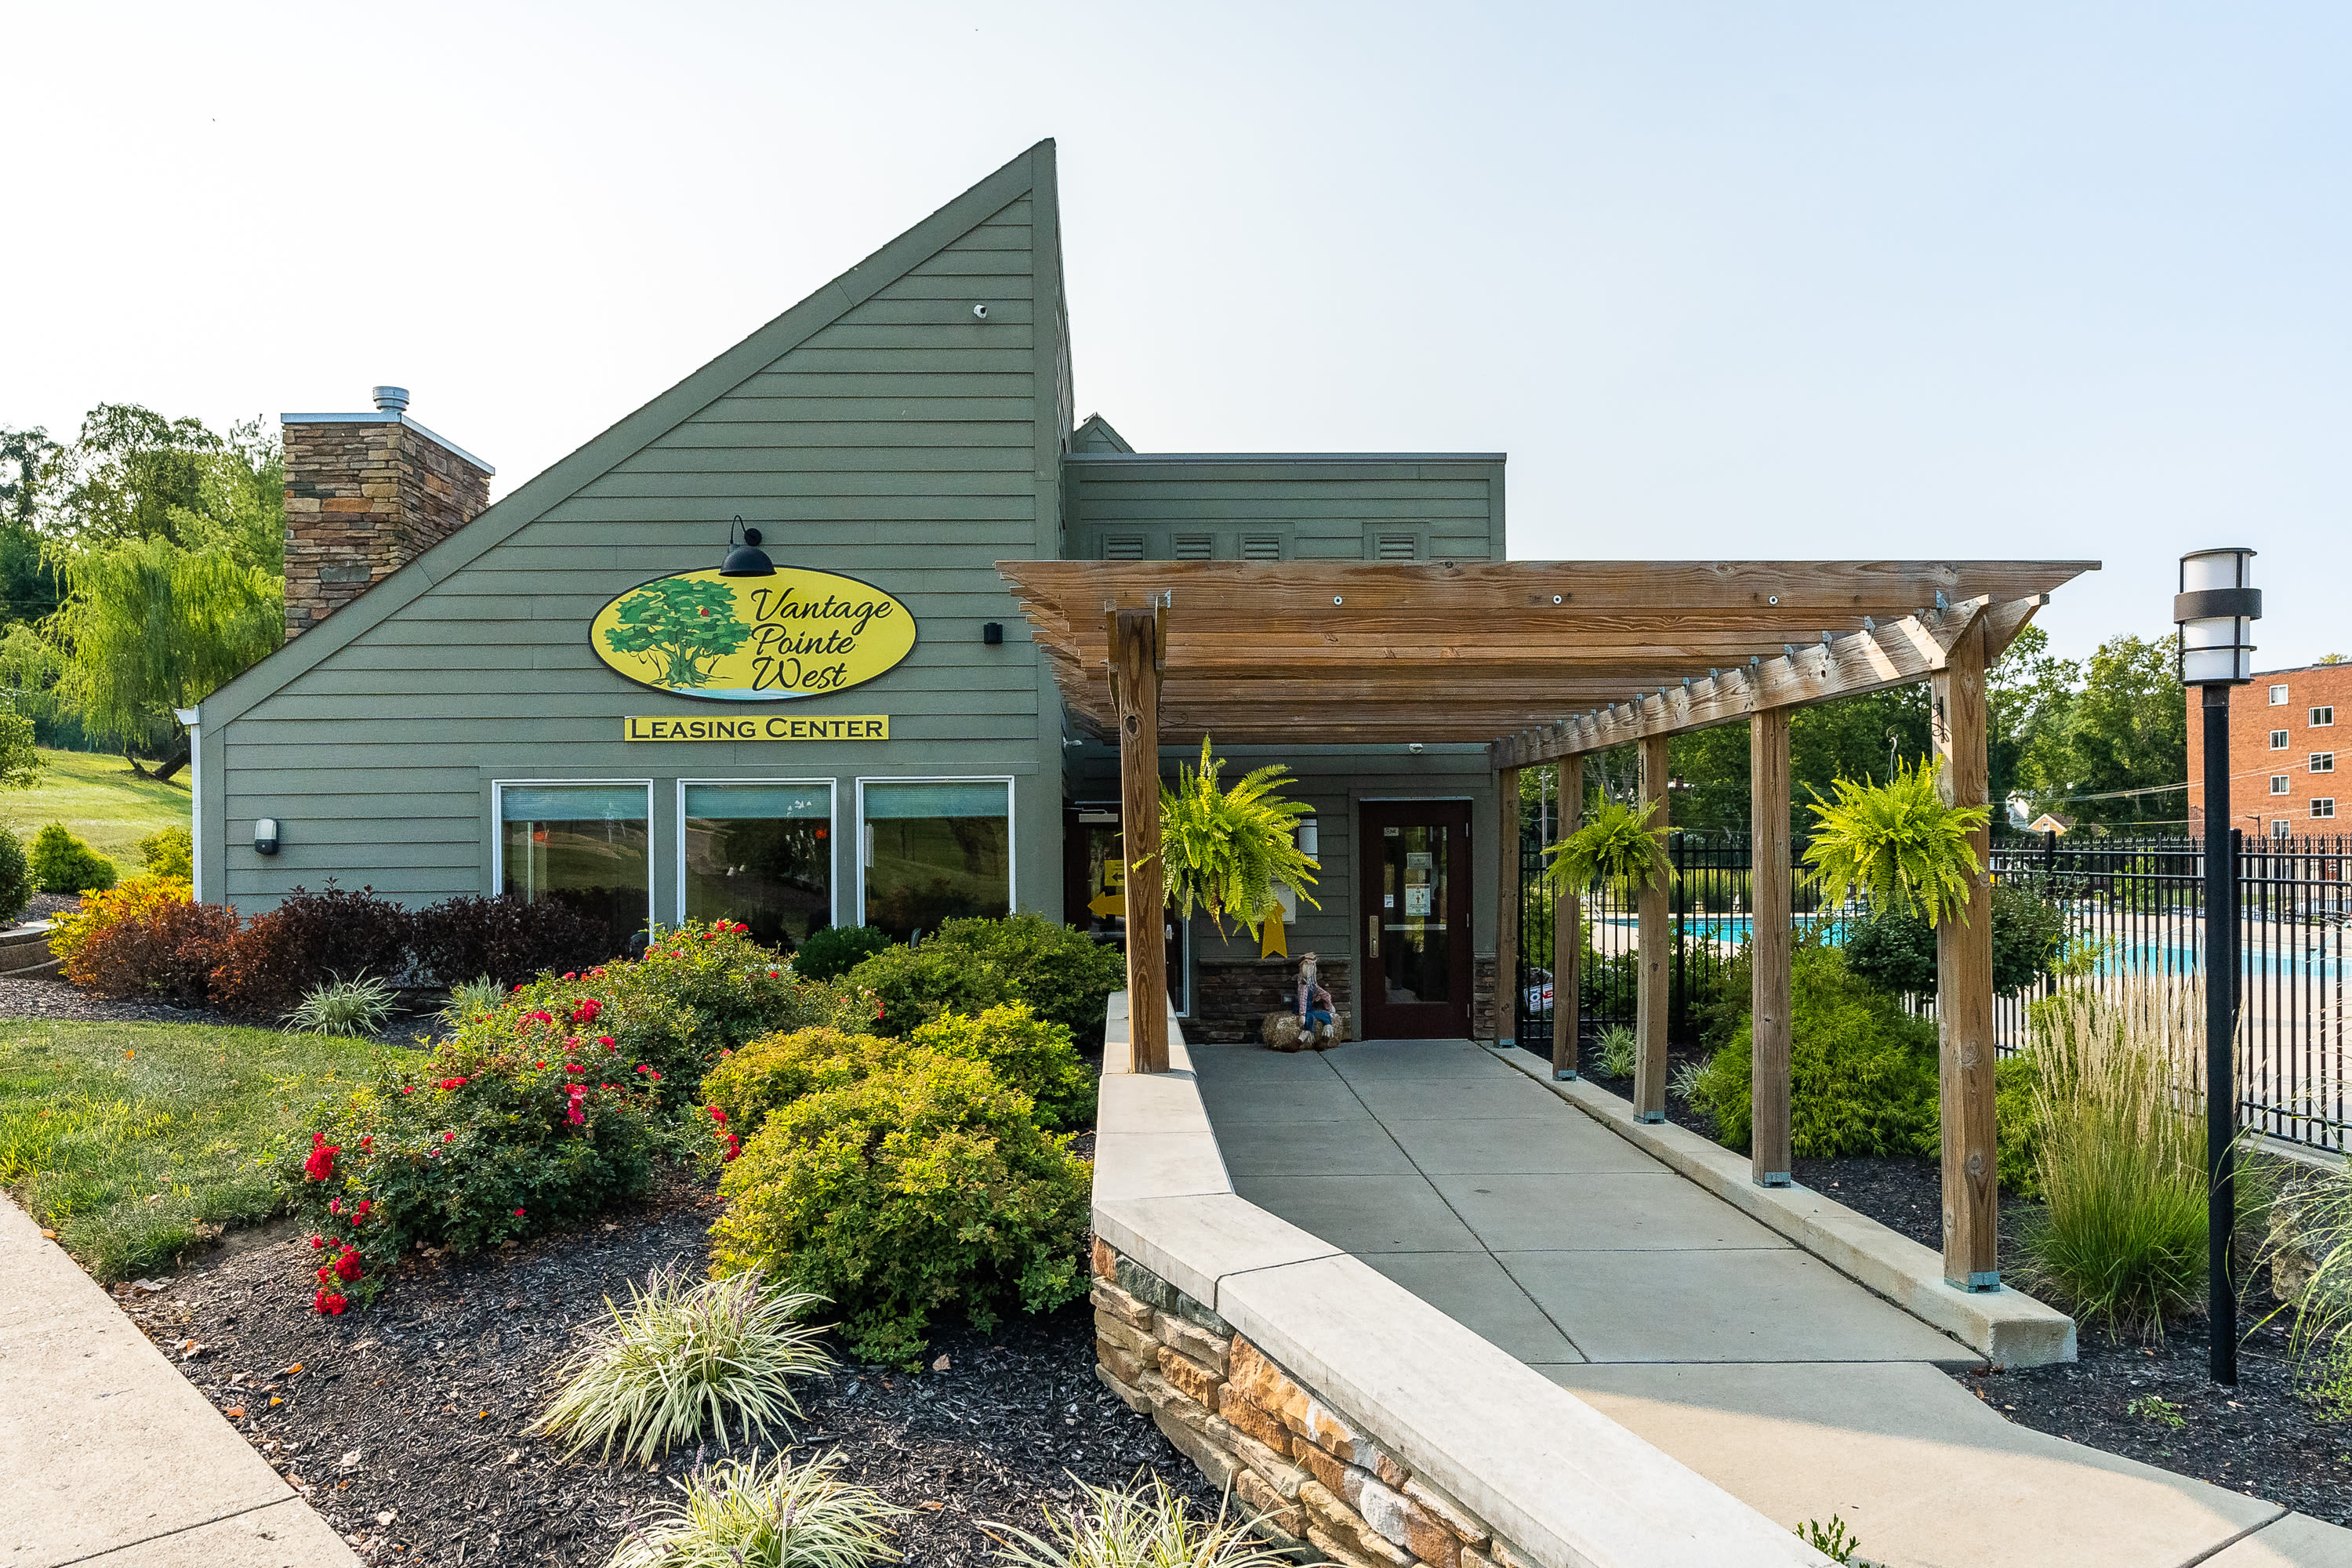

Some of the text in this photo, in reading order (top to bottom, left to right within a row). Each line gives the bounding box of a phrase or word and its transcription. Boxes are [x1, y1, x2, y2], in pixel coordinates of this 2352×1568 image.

[750, 588, 894, 635] Vantage
[750, 623, 856, 655] Pointe
[750, 656, 849, 691] West
[630, 717, 884, 739] LEASING CENTER
